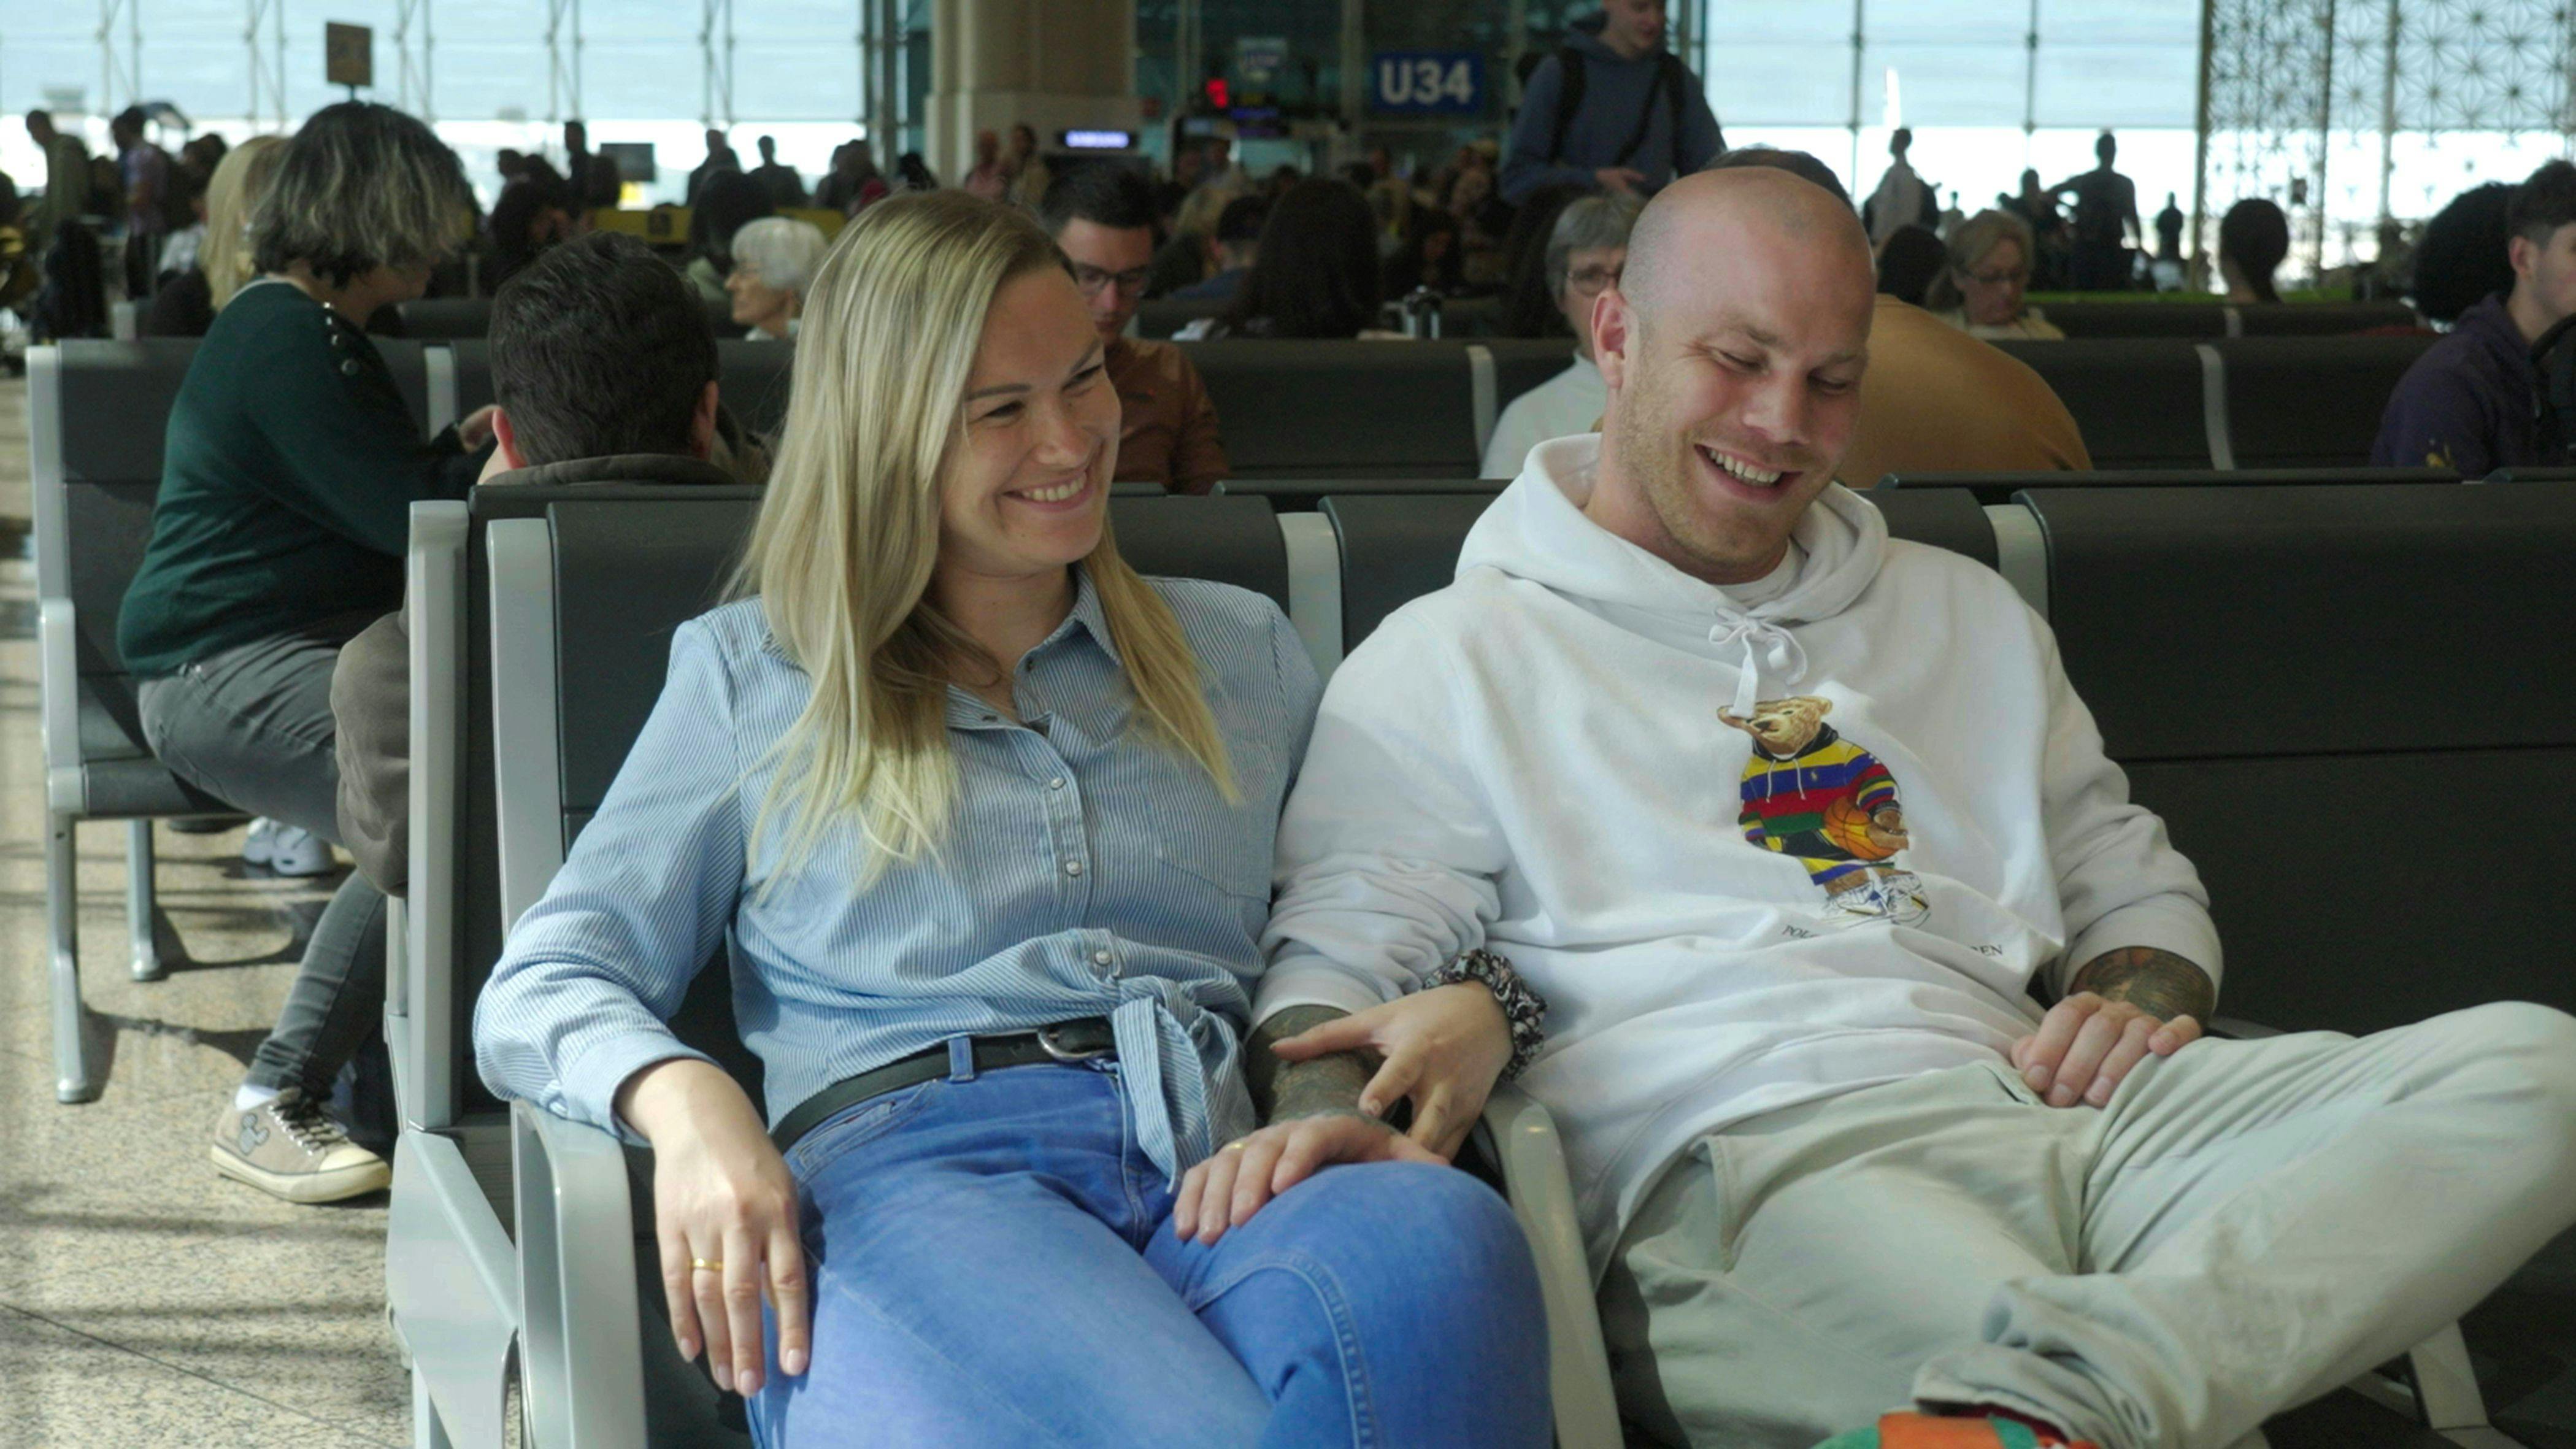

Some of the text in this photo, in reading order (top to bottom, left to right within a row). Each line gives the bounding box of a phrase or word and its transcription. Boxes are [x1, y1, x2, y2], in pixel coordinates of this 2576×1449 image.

[1380, 60, 1473, 105] U34
[1781, 924, 2003, 956] POL EN
